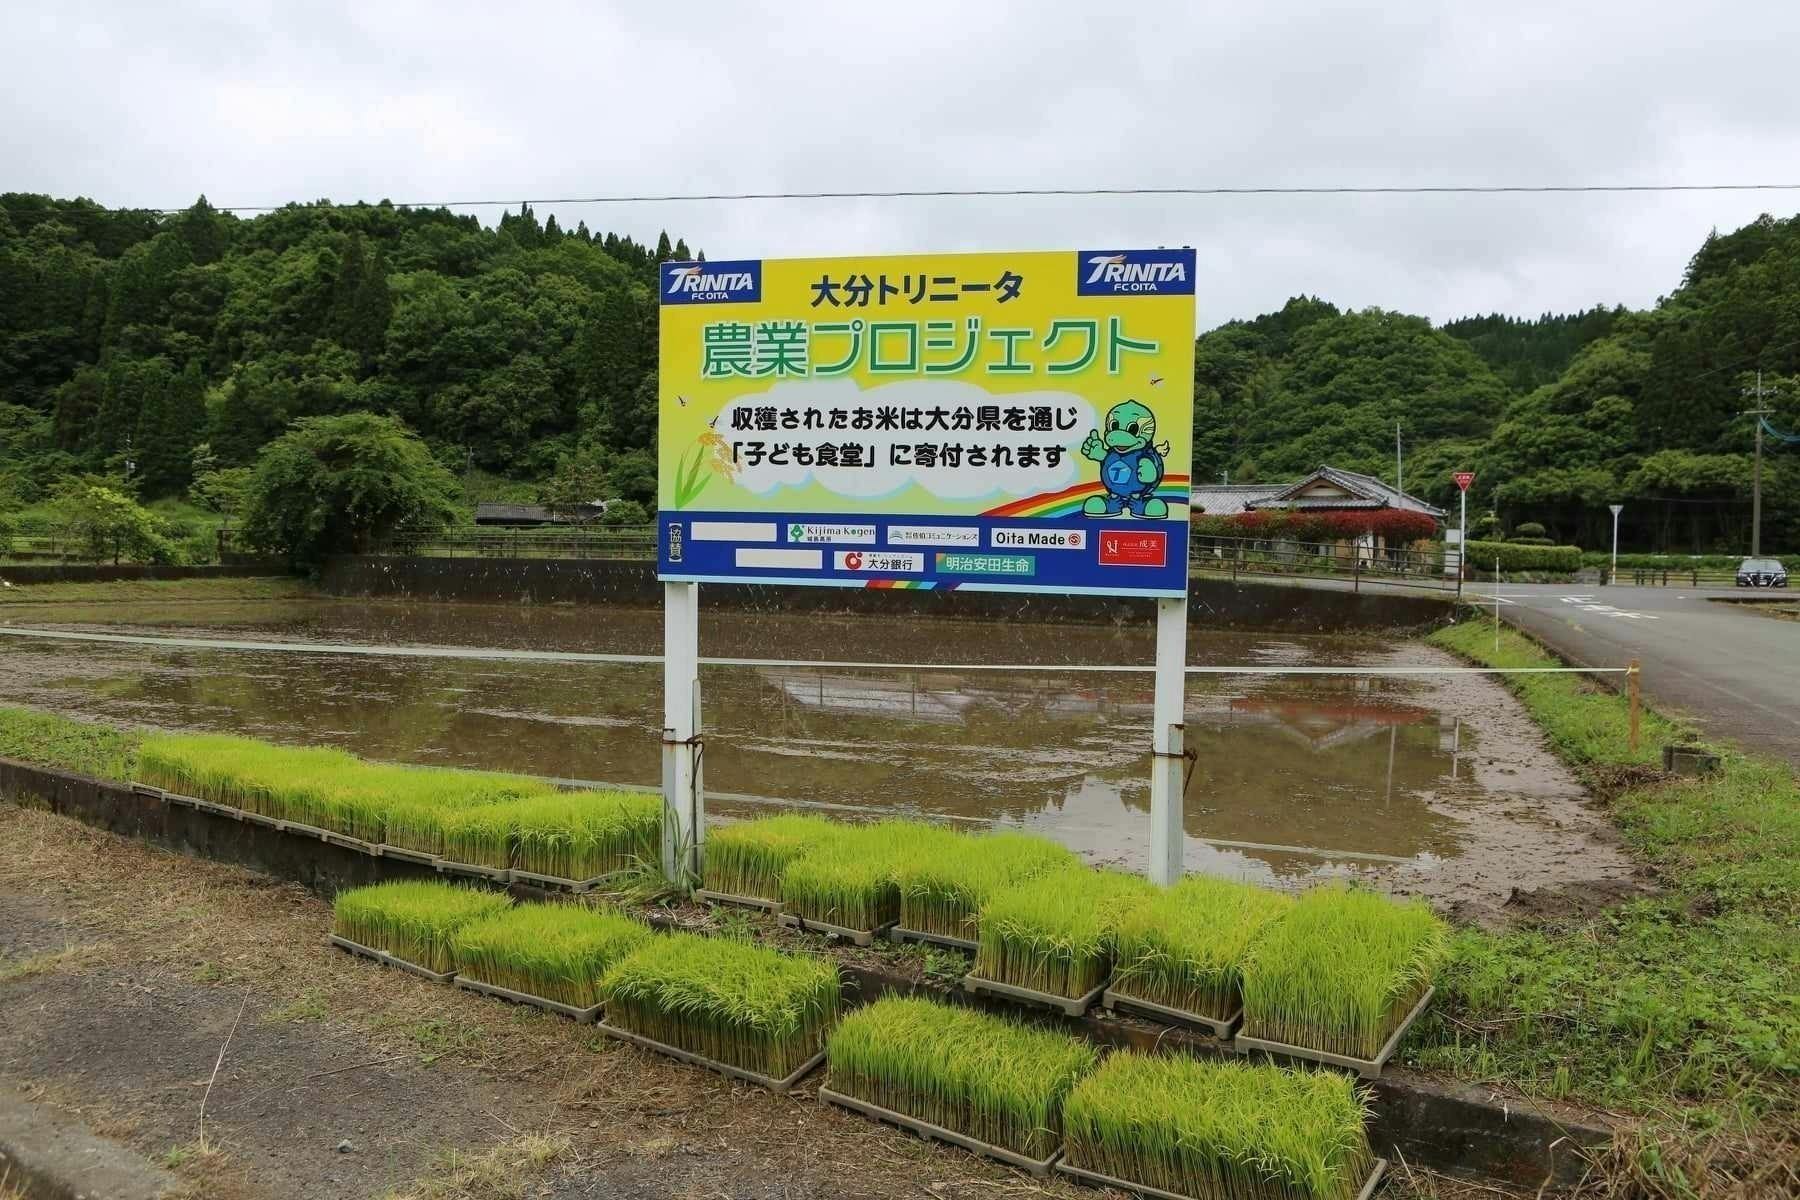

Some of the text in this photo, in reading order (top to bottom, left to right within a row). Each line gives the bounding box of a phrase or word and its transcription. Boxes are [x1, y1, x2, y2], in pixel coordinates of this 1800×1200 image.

[1086, 254, 1185, 284] TRINITA
[667, 265, 753, 294] TRINITA
[1114, 283, 1157, 292] FC OITA
[691, 291, 728, 300] FC OITA
[811, 270, 1024, 307] 大分トリニータ
[702, 317, 1157, 377] 農業プロジェクト
[731, 405, 1077, 431] 収穫されたお米は大分県を通じ
[807, 526, 841, 537] Kijima
[996, 532, 1065, 545] Oita Made
[868, 559, 912, 571] 大分銀行
[946, 556, 1030, 573] 明治安田生命
